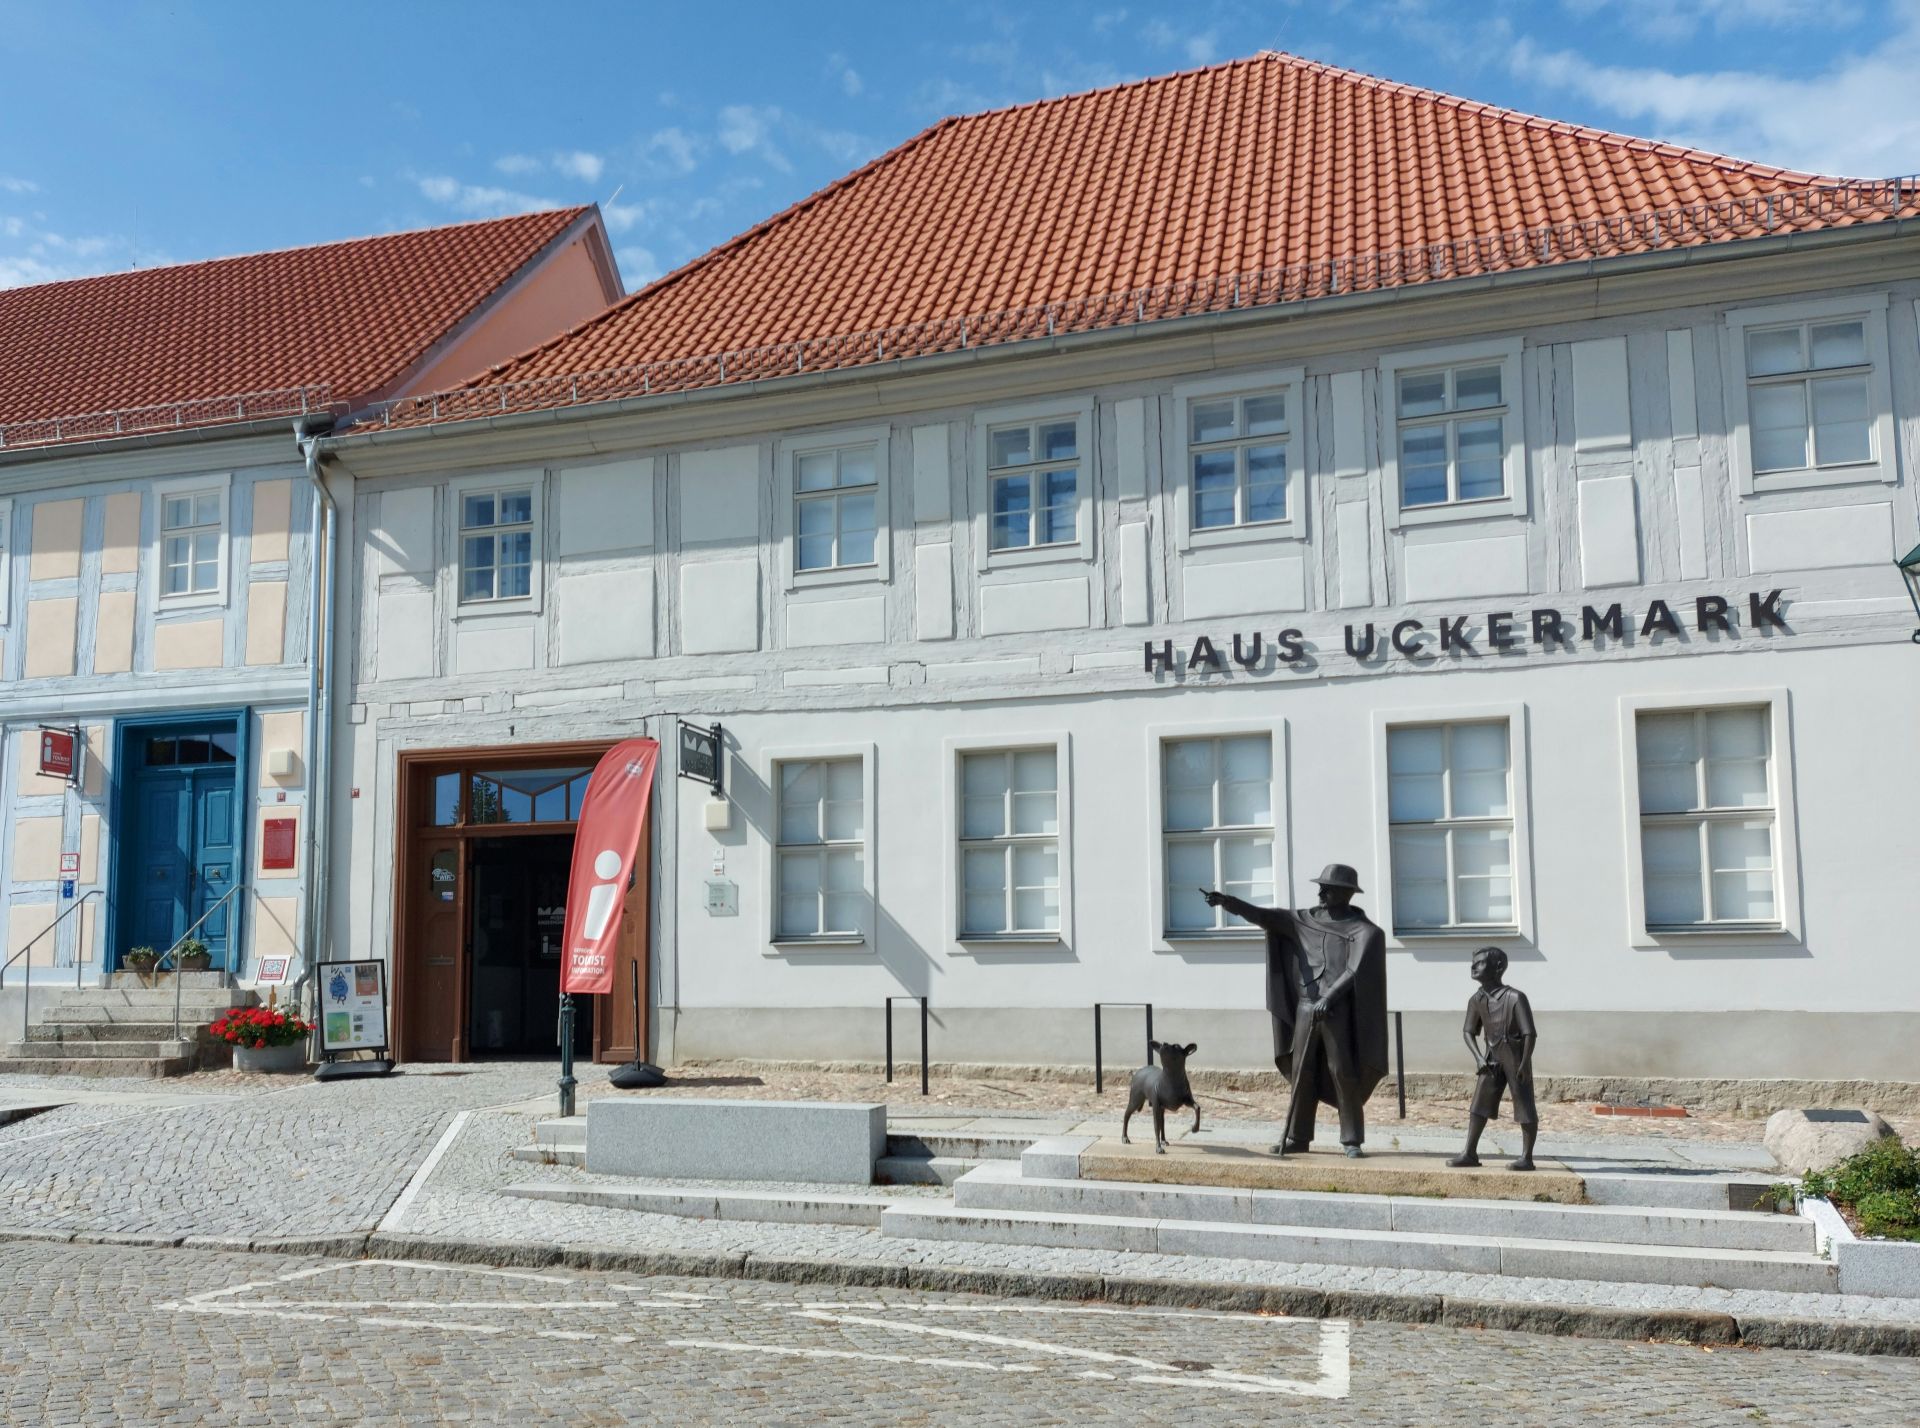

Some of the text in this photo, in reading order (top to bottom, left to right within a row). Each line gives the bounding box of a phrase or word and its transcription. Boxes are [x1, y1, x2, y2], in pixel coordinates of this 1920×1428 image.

[1144, 589, 1788, 672] HAUS UCKERMARK
[684, 733, 713, 757] MA
